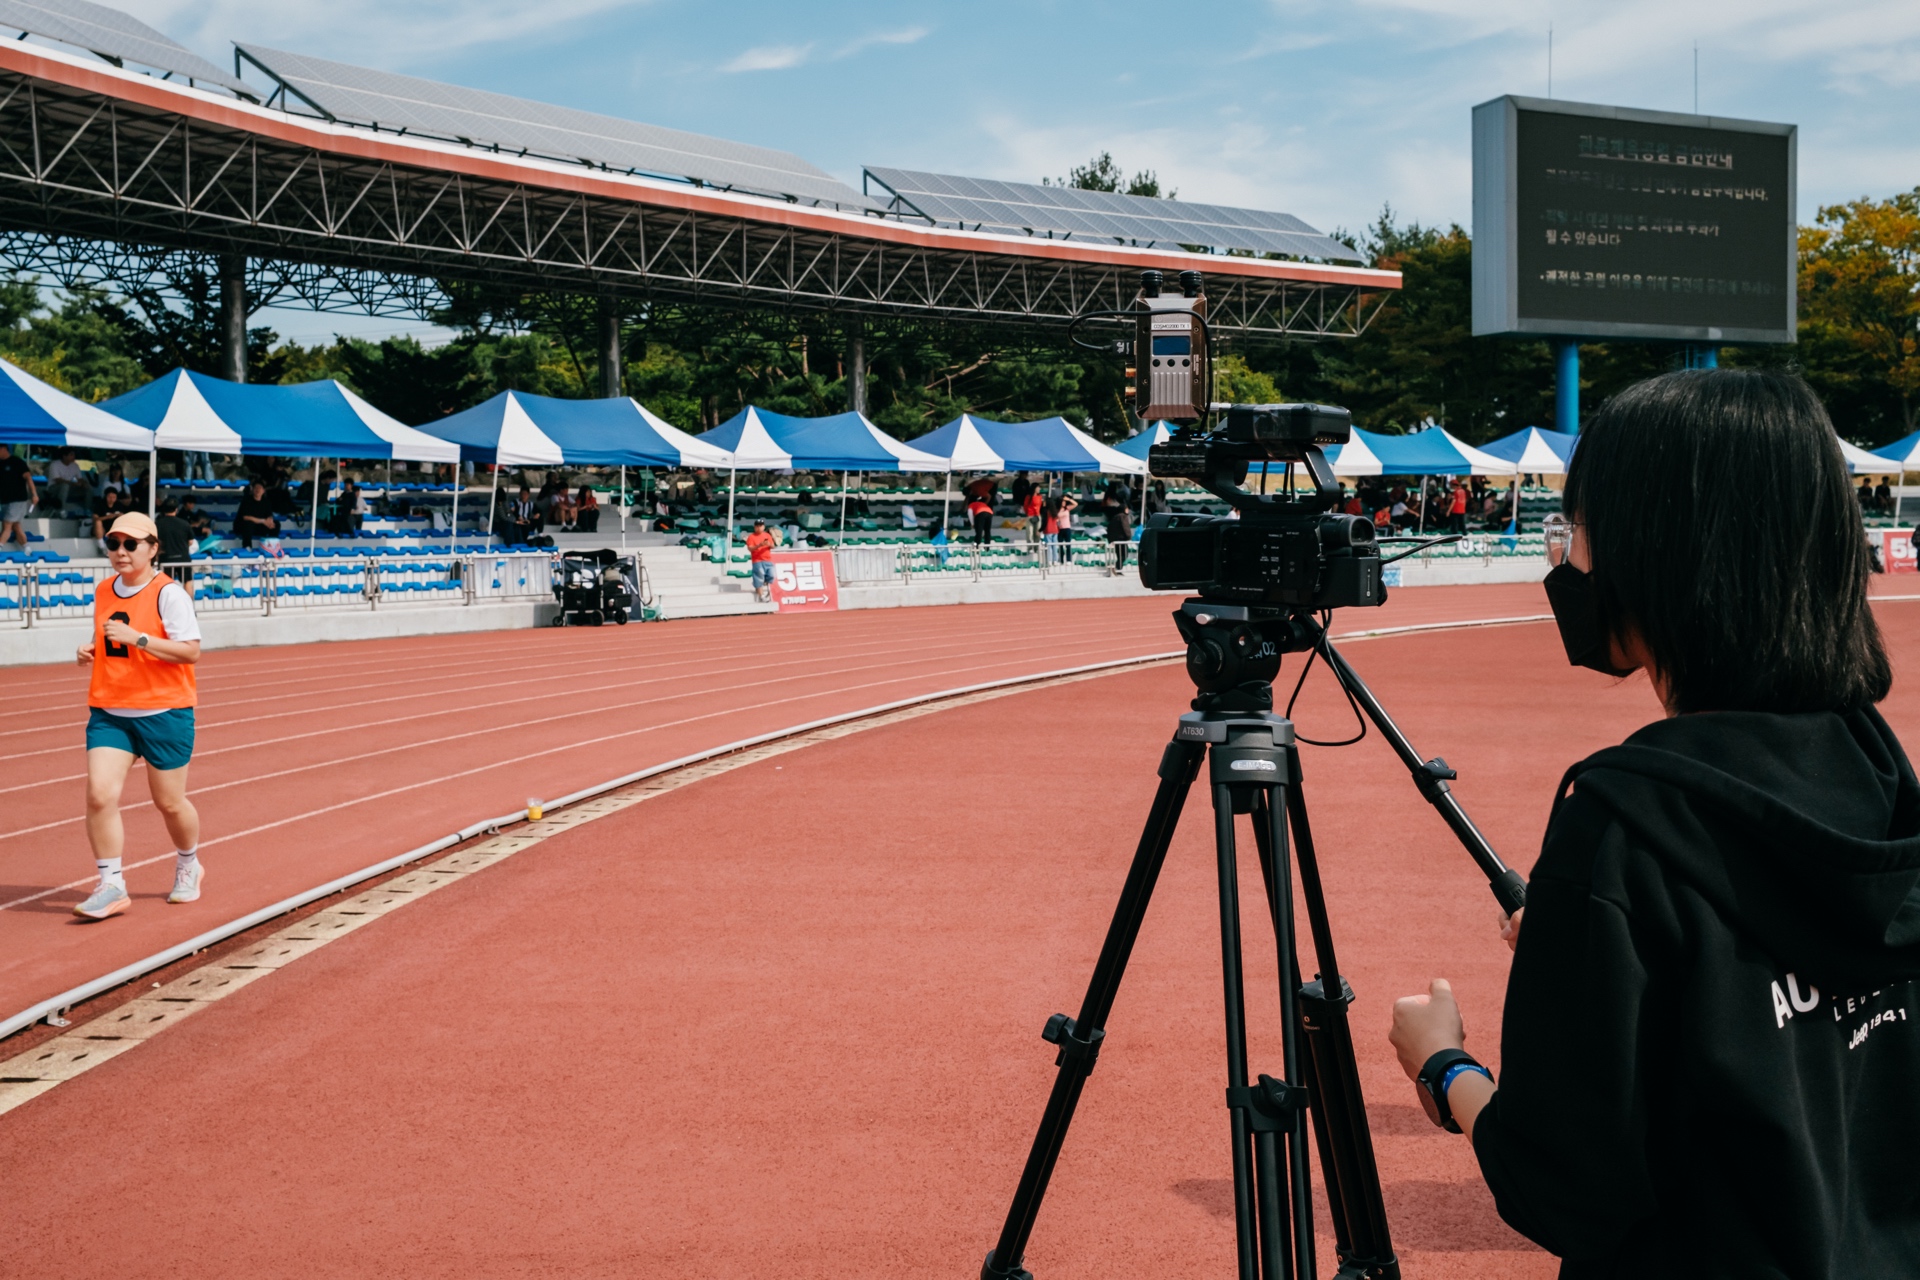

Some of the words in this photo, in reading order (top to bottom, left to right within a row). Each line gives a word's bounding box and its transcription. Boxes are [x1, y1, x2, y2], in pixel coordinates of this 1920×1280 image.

[1559, 230, 1571, 245] 수
[1182, 726, 1205, 736] AT630
[1870, 1008, 1907, 1030] 1941
